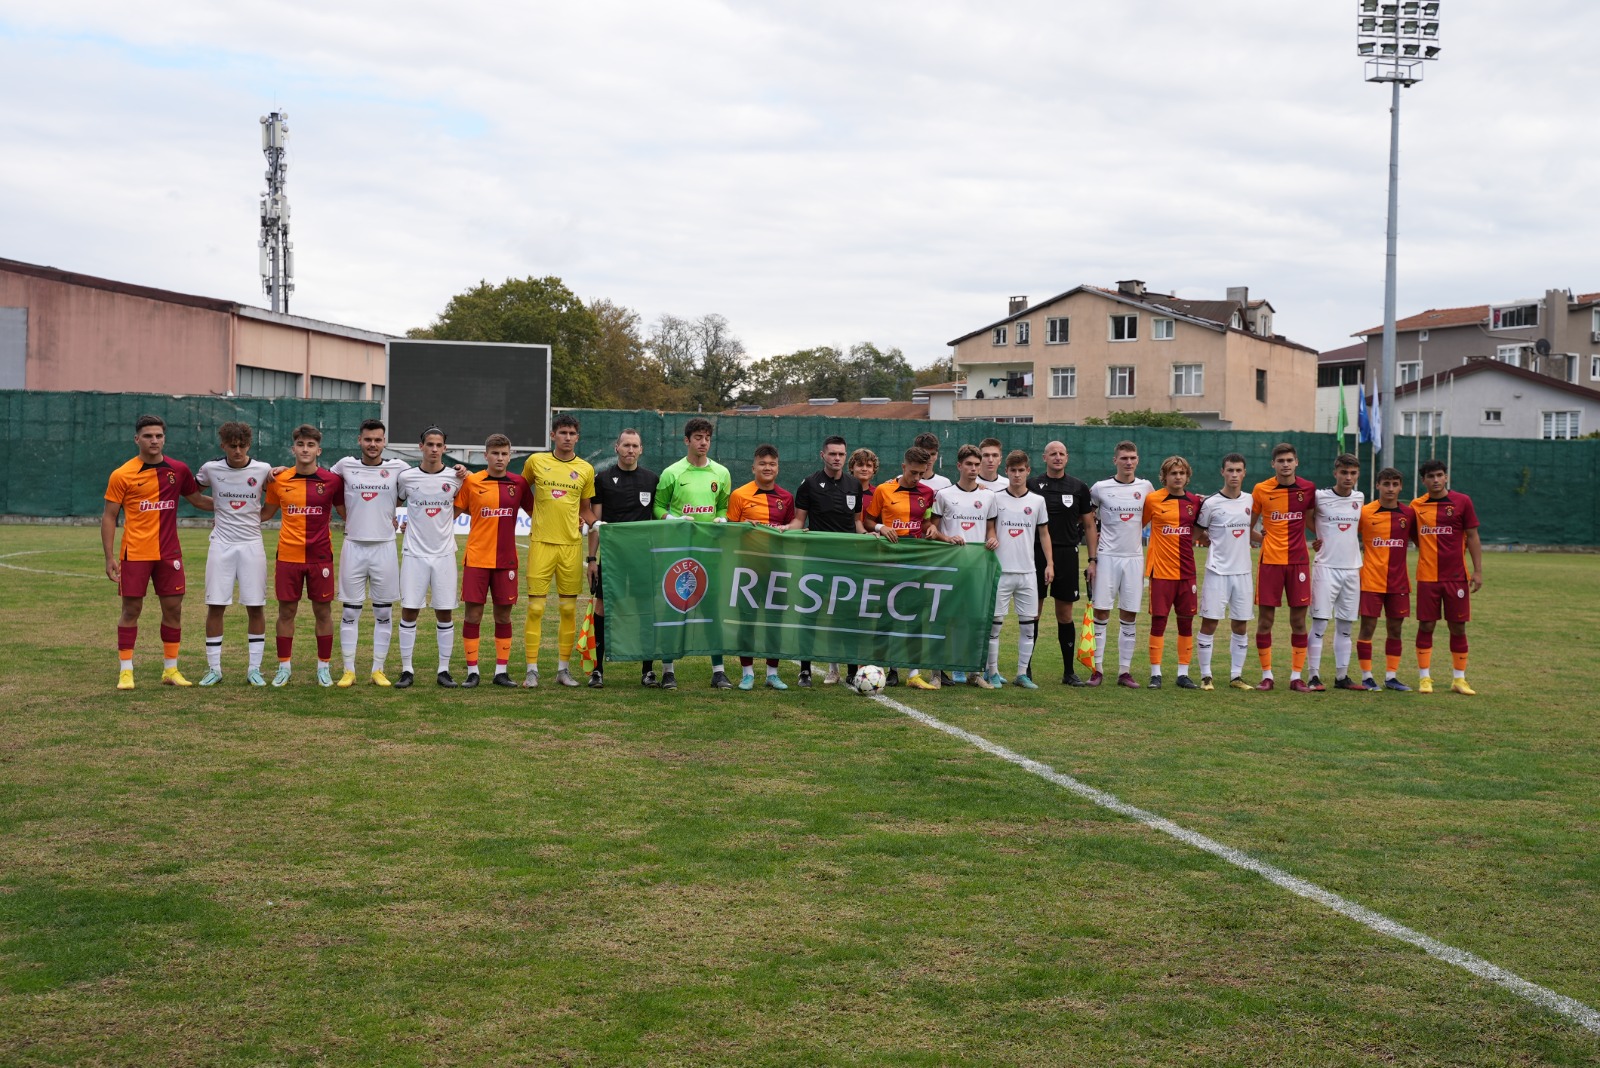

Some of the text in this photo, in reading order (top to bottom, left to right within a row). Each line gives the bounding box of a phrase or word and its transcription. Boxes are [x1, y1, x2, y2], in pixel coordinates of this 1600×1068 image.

[140, 500, 175, 512] ÜLKER
[288, 504, 322, 515] ÜLKER
[683, 504, 714, 514] ÜLKER
[481, 507, 513, 517] ÜLKER
[1271, 511, 1302, 520] ÜLKER
[892, 519, 921, 529] ÜLKER
[1162, 525, 1190, 535] ÜLKER
[1421, 525, 1452, 534] ÜLKER
[1372, 537, 1403, 547] ÜLKER
[673, 561, 699, 574] UEFA
[729, 567, 953, 622] RESPECT
